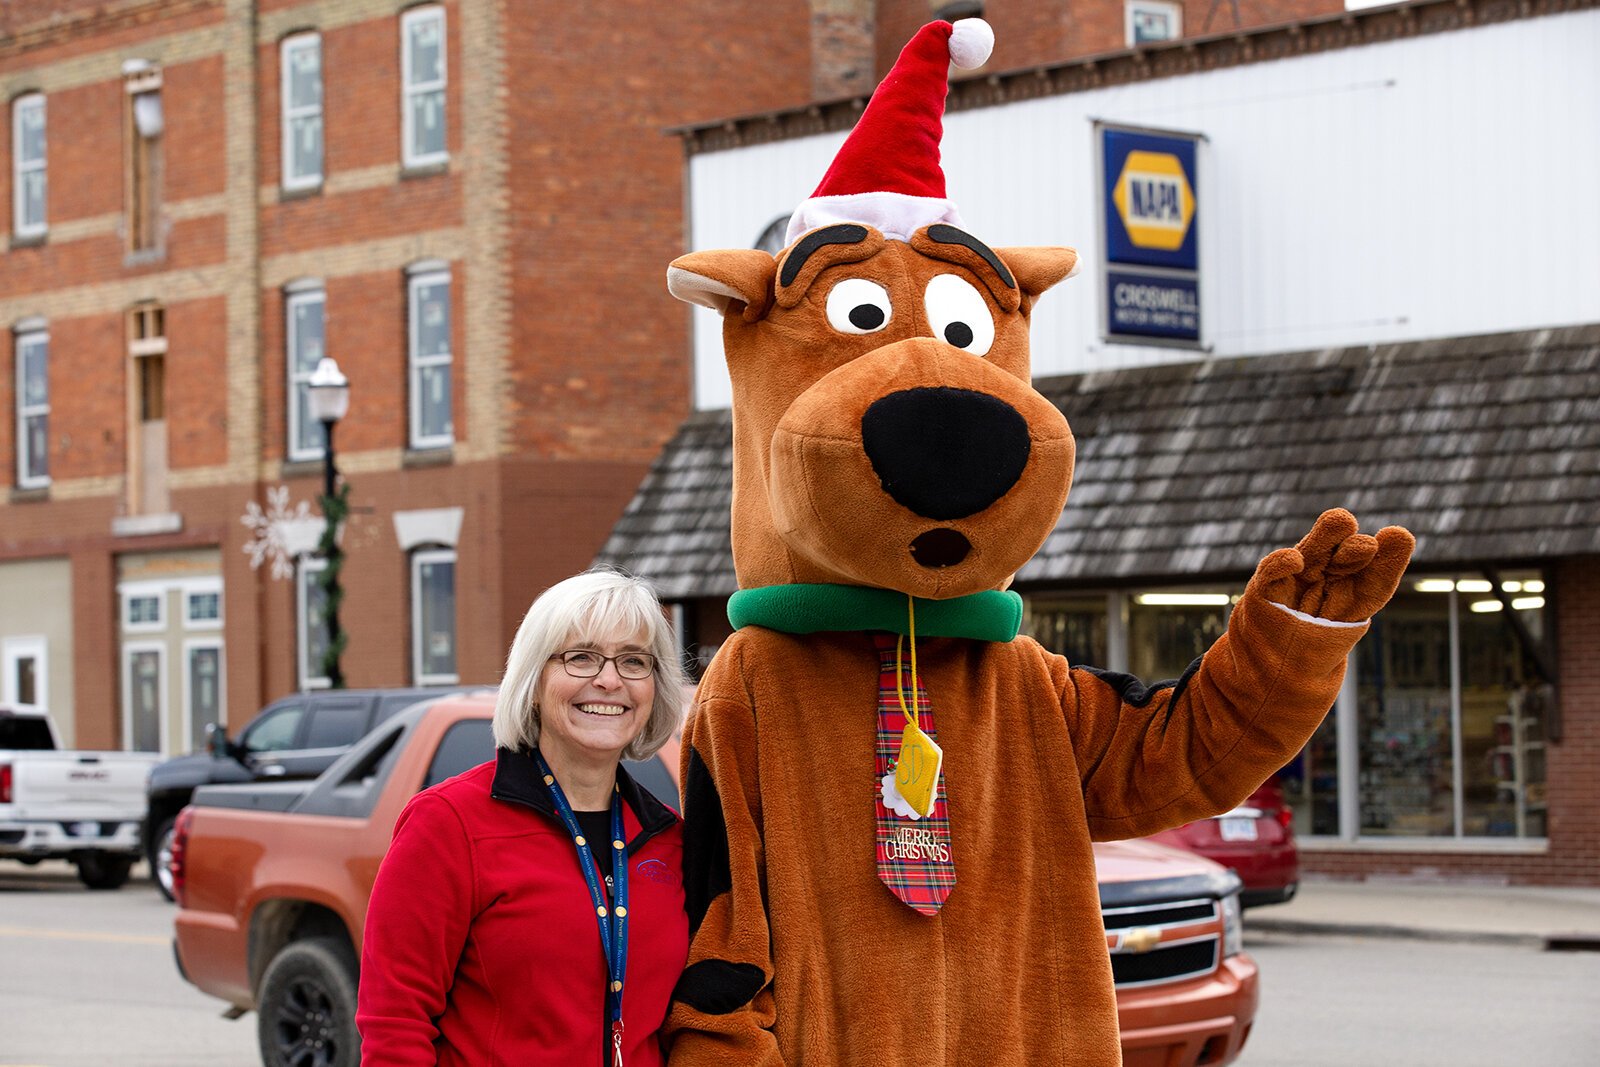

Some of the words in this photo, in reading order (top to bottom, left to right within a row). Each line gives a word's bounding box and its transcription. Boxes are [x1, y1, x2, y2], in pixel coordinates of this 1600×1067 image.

[1131, 179, 1180, 220] NAPA
[1114, 283, 1199, 313] CROSWELL
[894, 827, 941, 846] MERRY
[885, 840, 949, 862] CHRISTMAS
